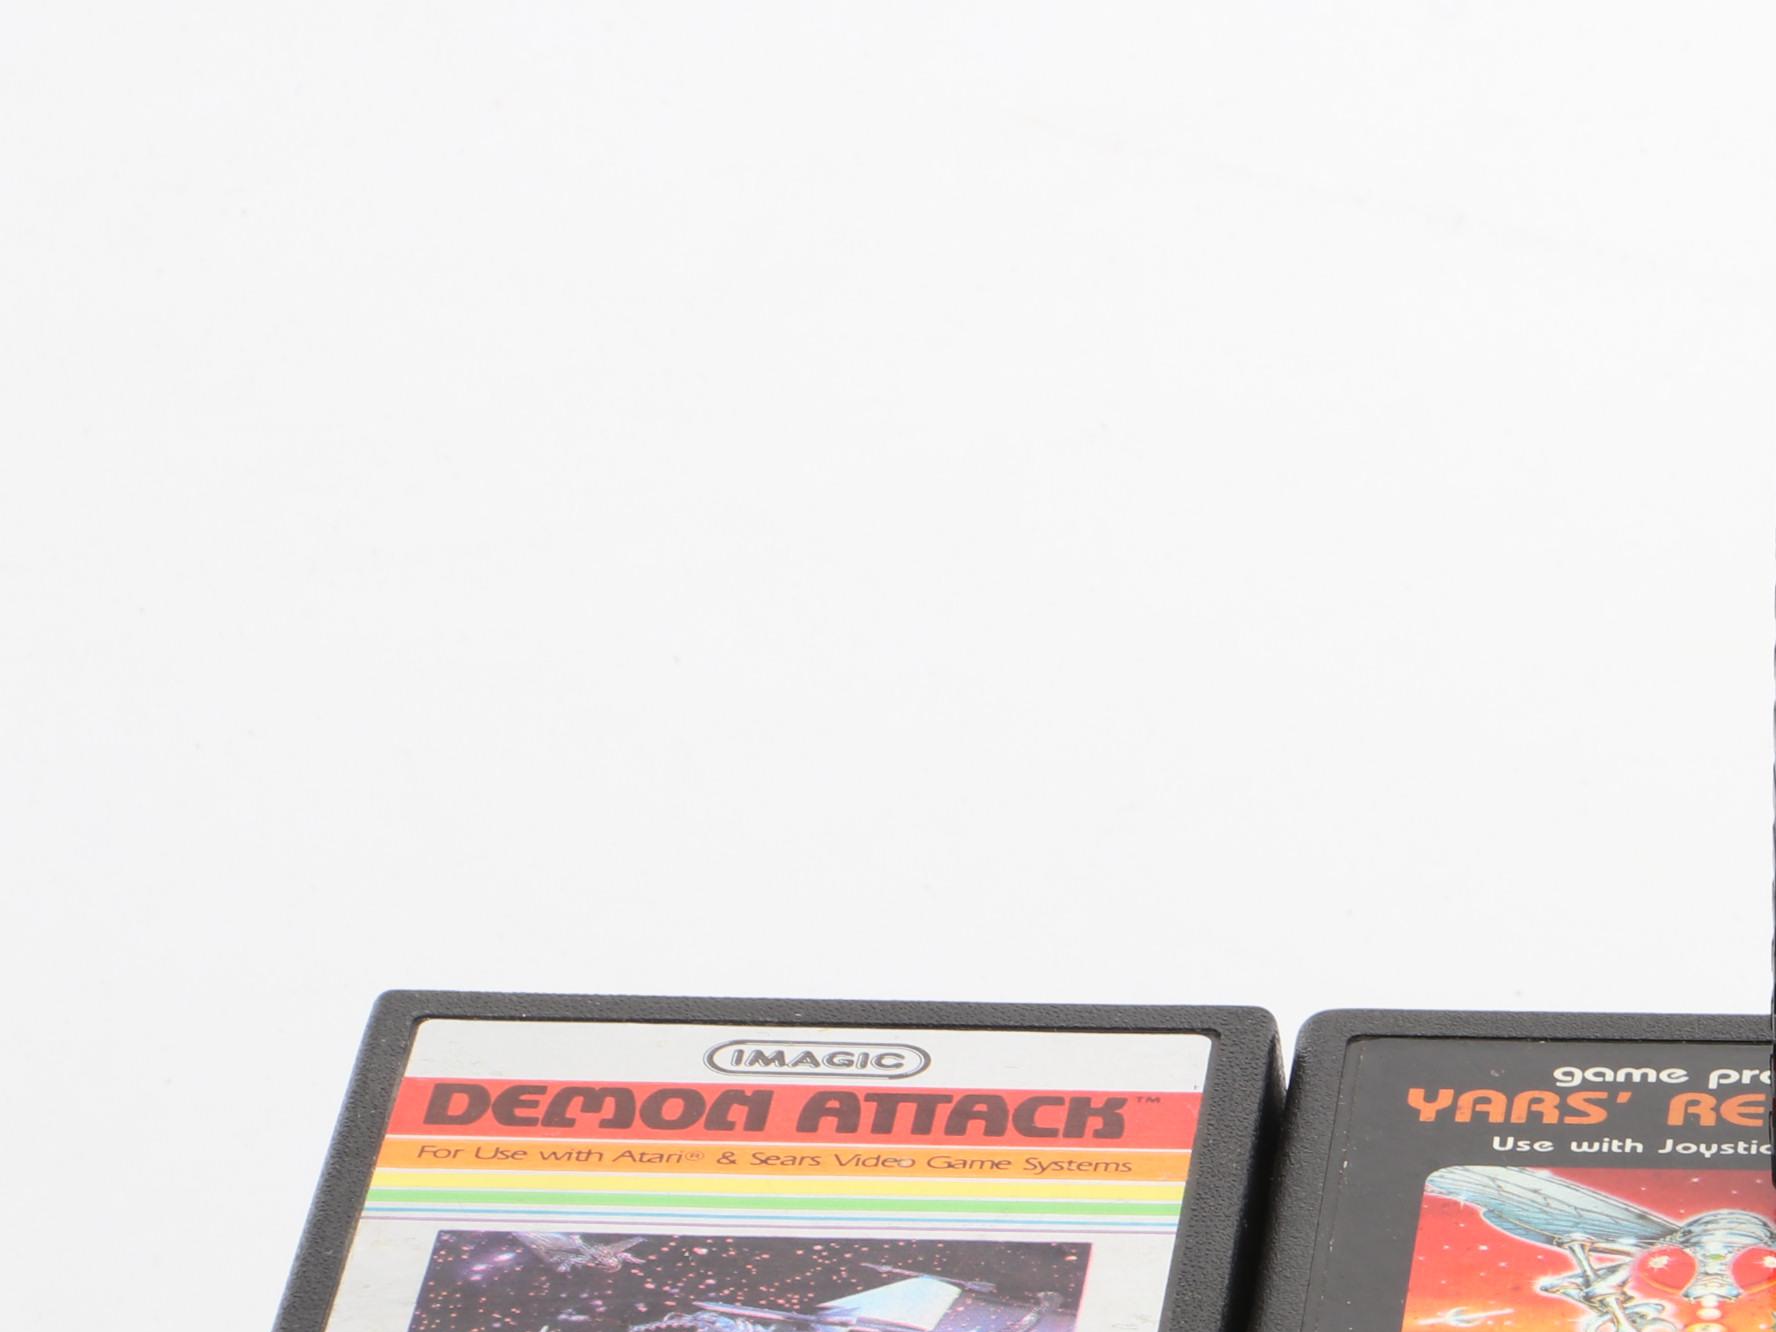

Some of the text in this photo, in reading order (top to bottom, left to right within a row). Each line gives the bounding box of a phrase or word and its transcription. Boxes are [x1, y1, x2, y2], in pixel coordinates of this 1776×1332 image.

[729, 1048, 906, 1070] IMAGIC
[1553, 1066, 1772, 1090] game pro
[422, 1082, 775, 1133] DEMON
[1666, 1092, 1767, 1127] RE
[416, 1144, 467, 1160] For
[475, 1146, 528, 1162] Use
[540, 1148, 604, 1163] with
[716, 1151, 737, 1166] &
[750, 1151, 822, 1168] Sears
[834, 1152, 916, 1169] Video
[926, 1156, 1012, 1171] Game
[1023, 1157, 1133, 1175] Systems
[1491, 1136, 1772, 1159] Use with Joystic
